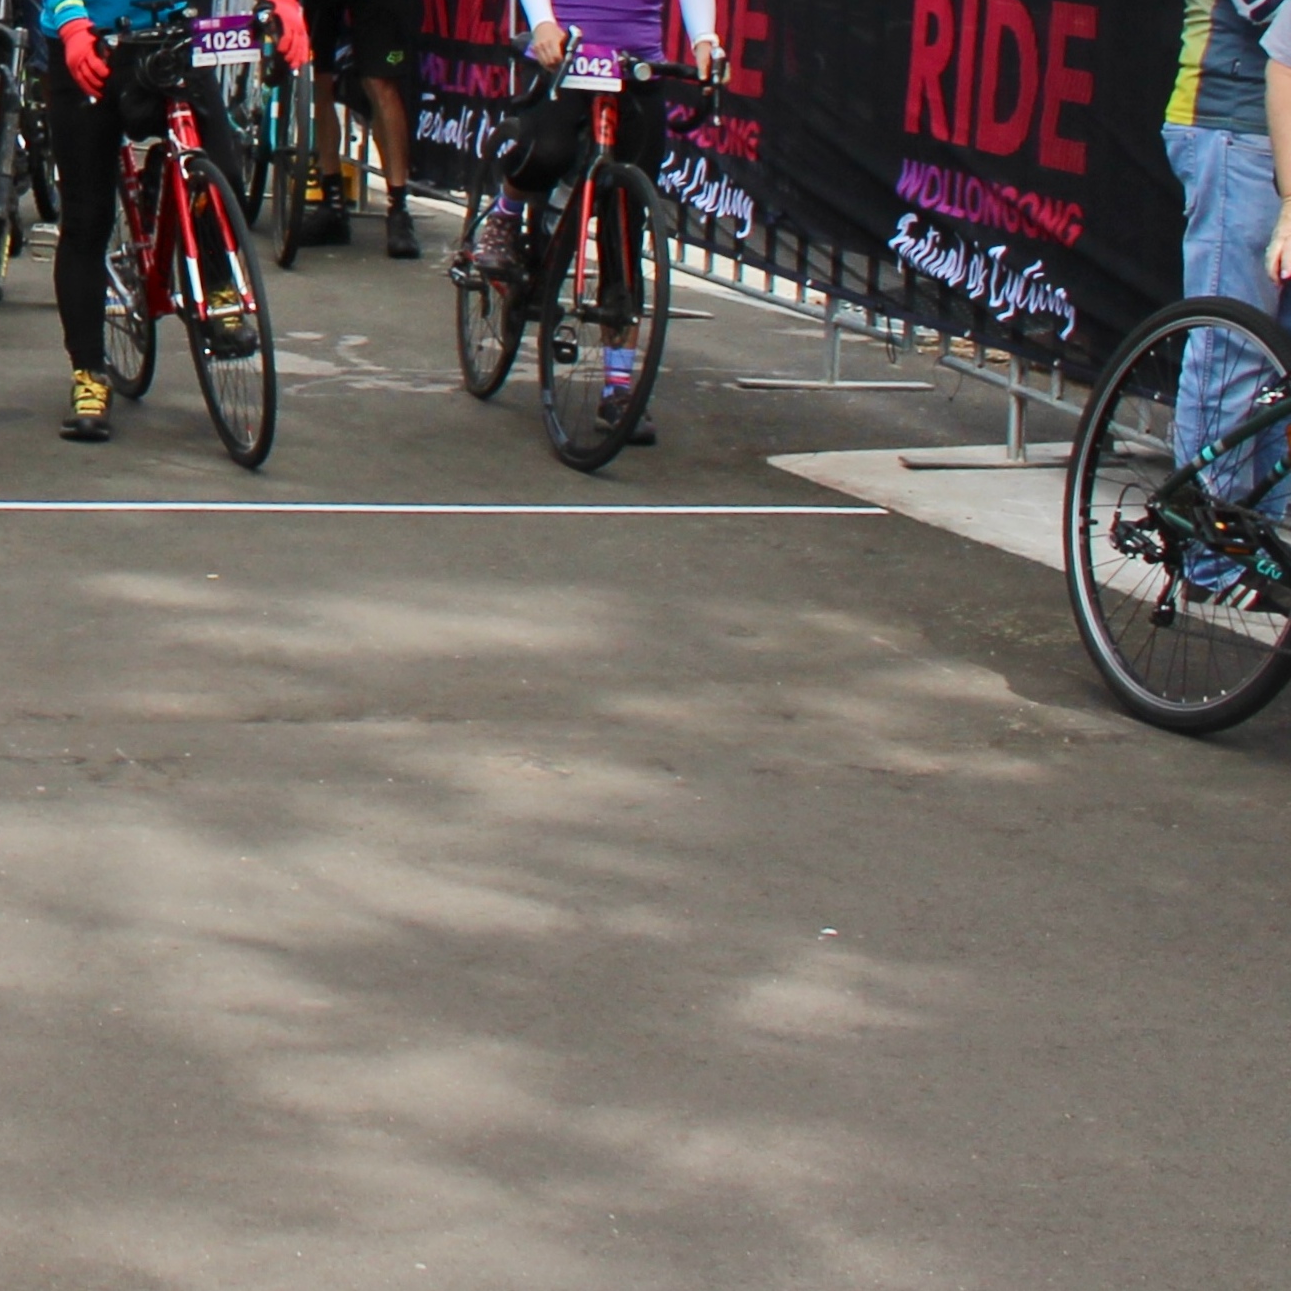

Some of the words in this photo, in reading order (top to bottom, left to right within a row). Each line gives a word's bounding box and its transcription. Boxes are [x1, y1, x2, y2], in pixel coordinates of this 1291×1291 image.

[201, 29, 252, 51] 1026
[568, 55, 613, 78] 1042
[896, 157, 1086, 248] WOLLONGONG
